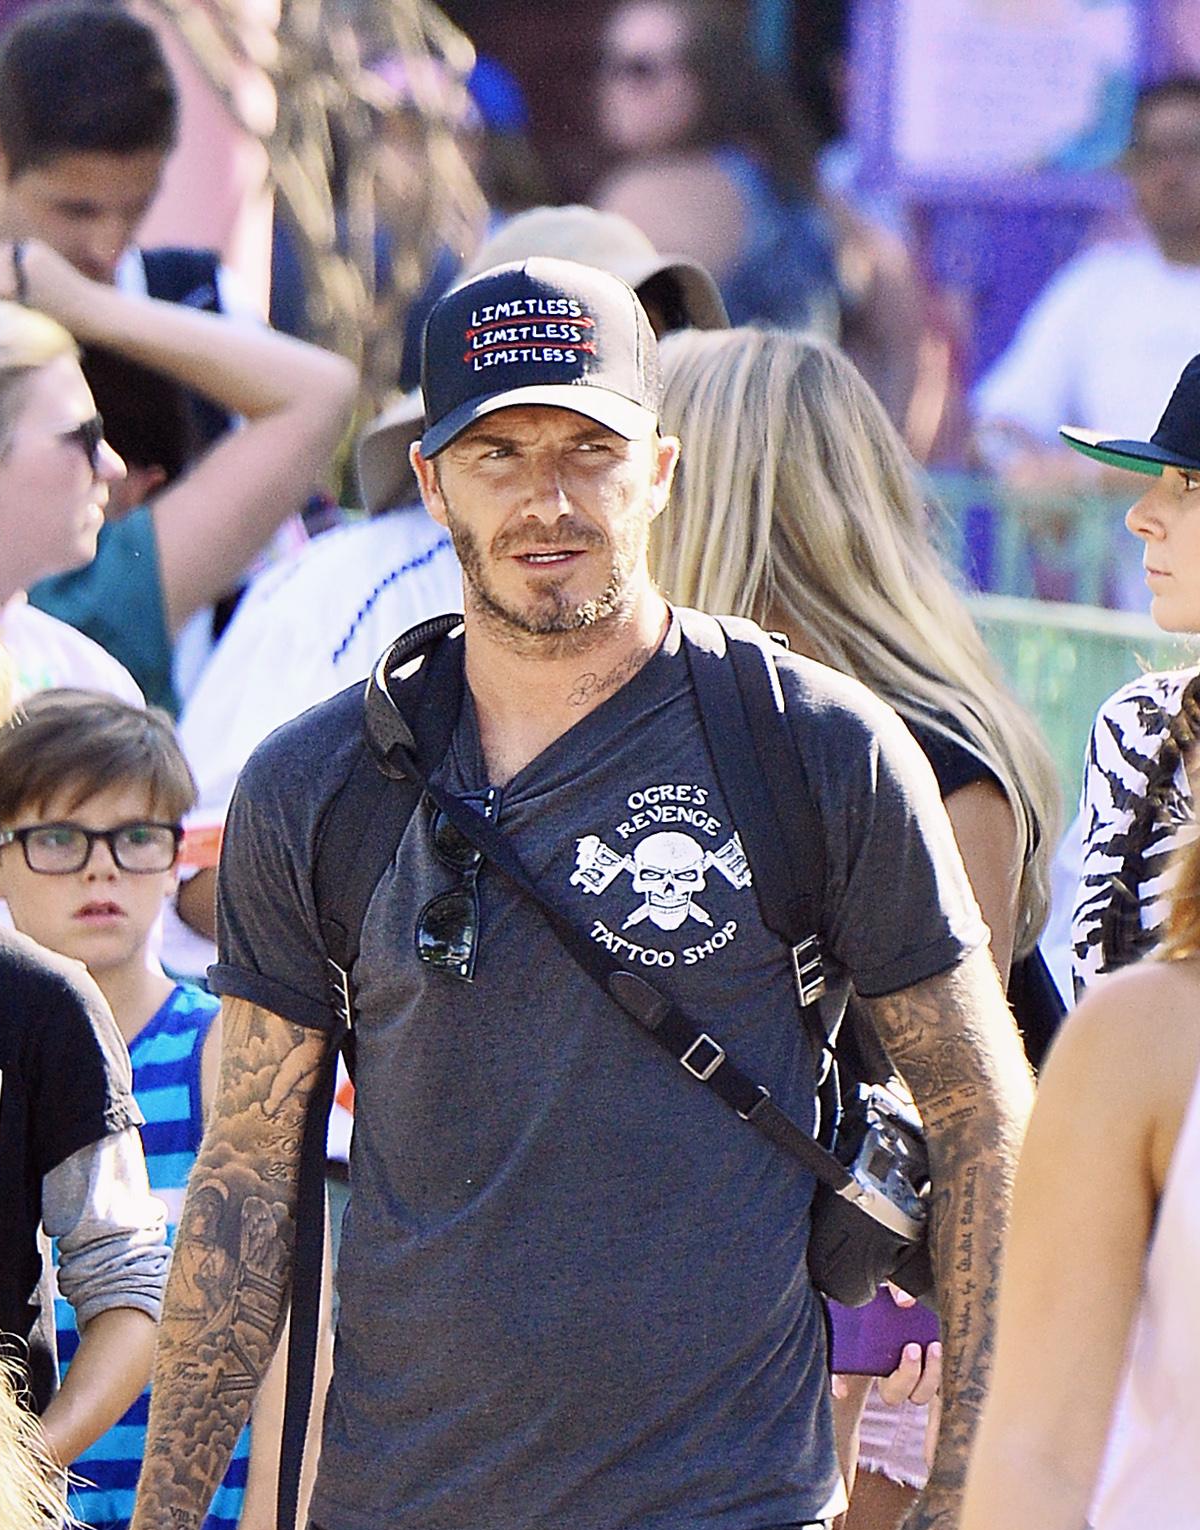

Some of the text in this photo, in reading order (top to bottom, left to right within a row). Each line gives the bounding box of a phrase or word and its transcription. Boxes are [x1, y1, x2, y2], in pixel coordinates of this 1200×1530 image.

[472, 299, 581, 327] LIMITLESS
[473, 325, 582, 349] LIMITLESS
[474, 348, 577, 371] LIMITLESS
[628, 785, 708, 809] OGRE'S
[616, 806, 721, 839] REVENGE
[590, 920, 738, 967] TATTOO SHOP
